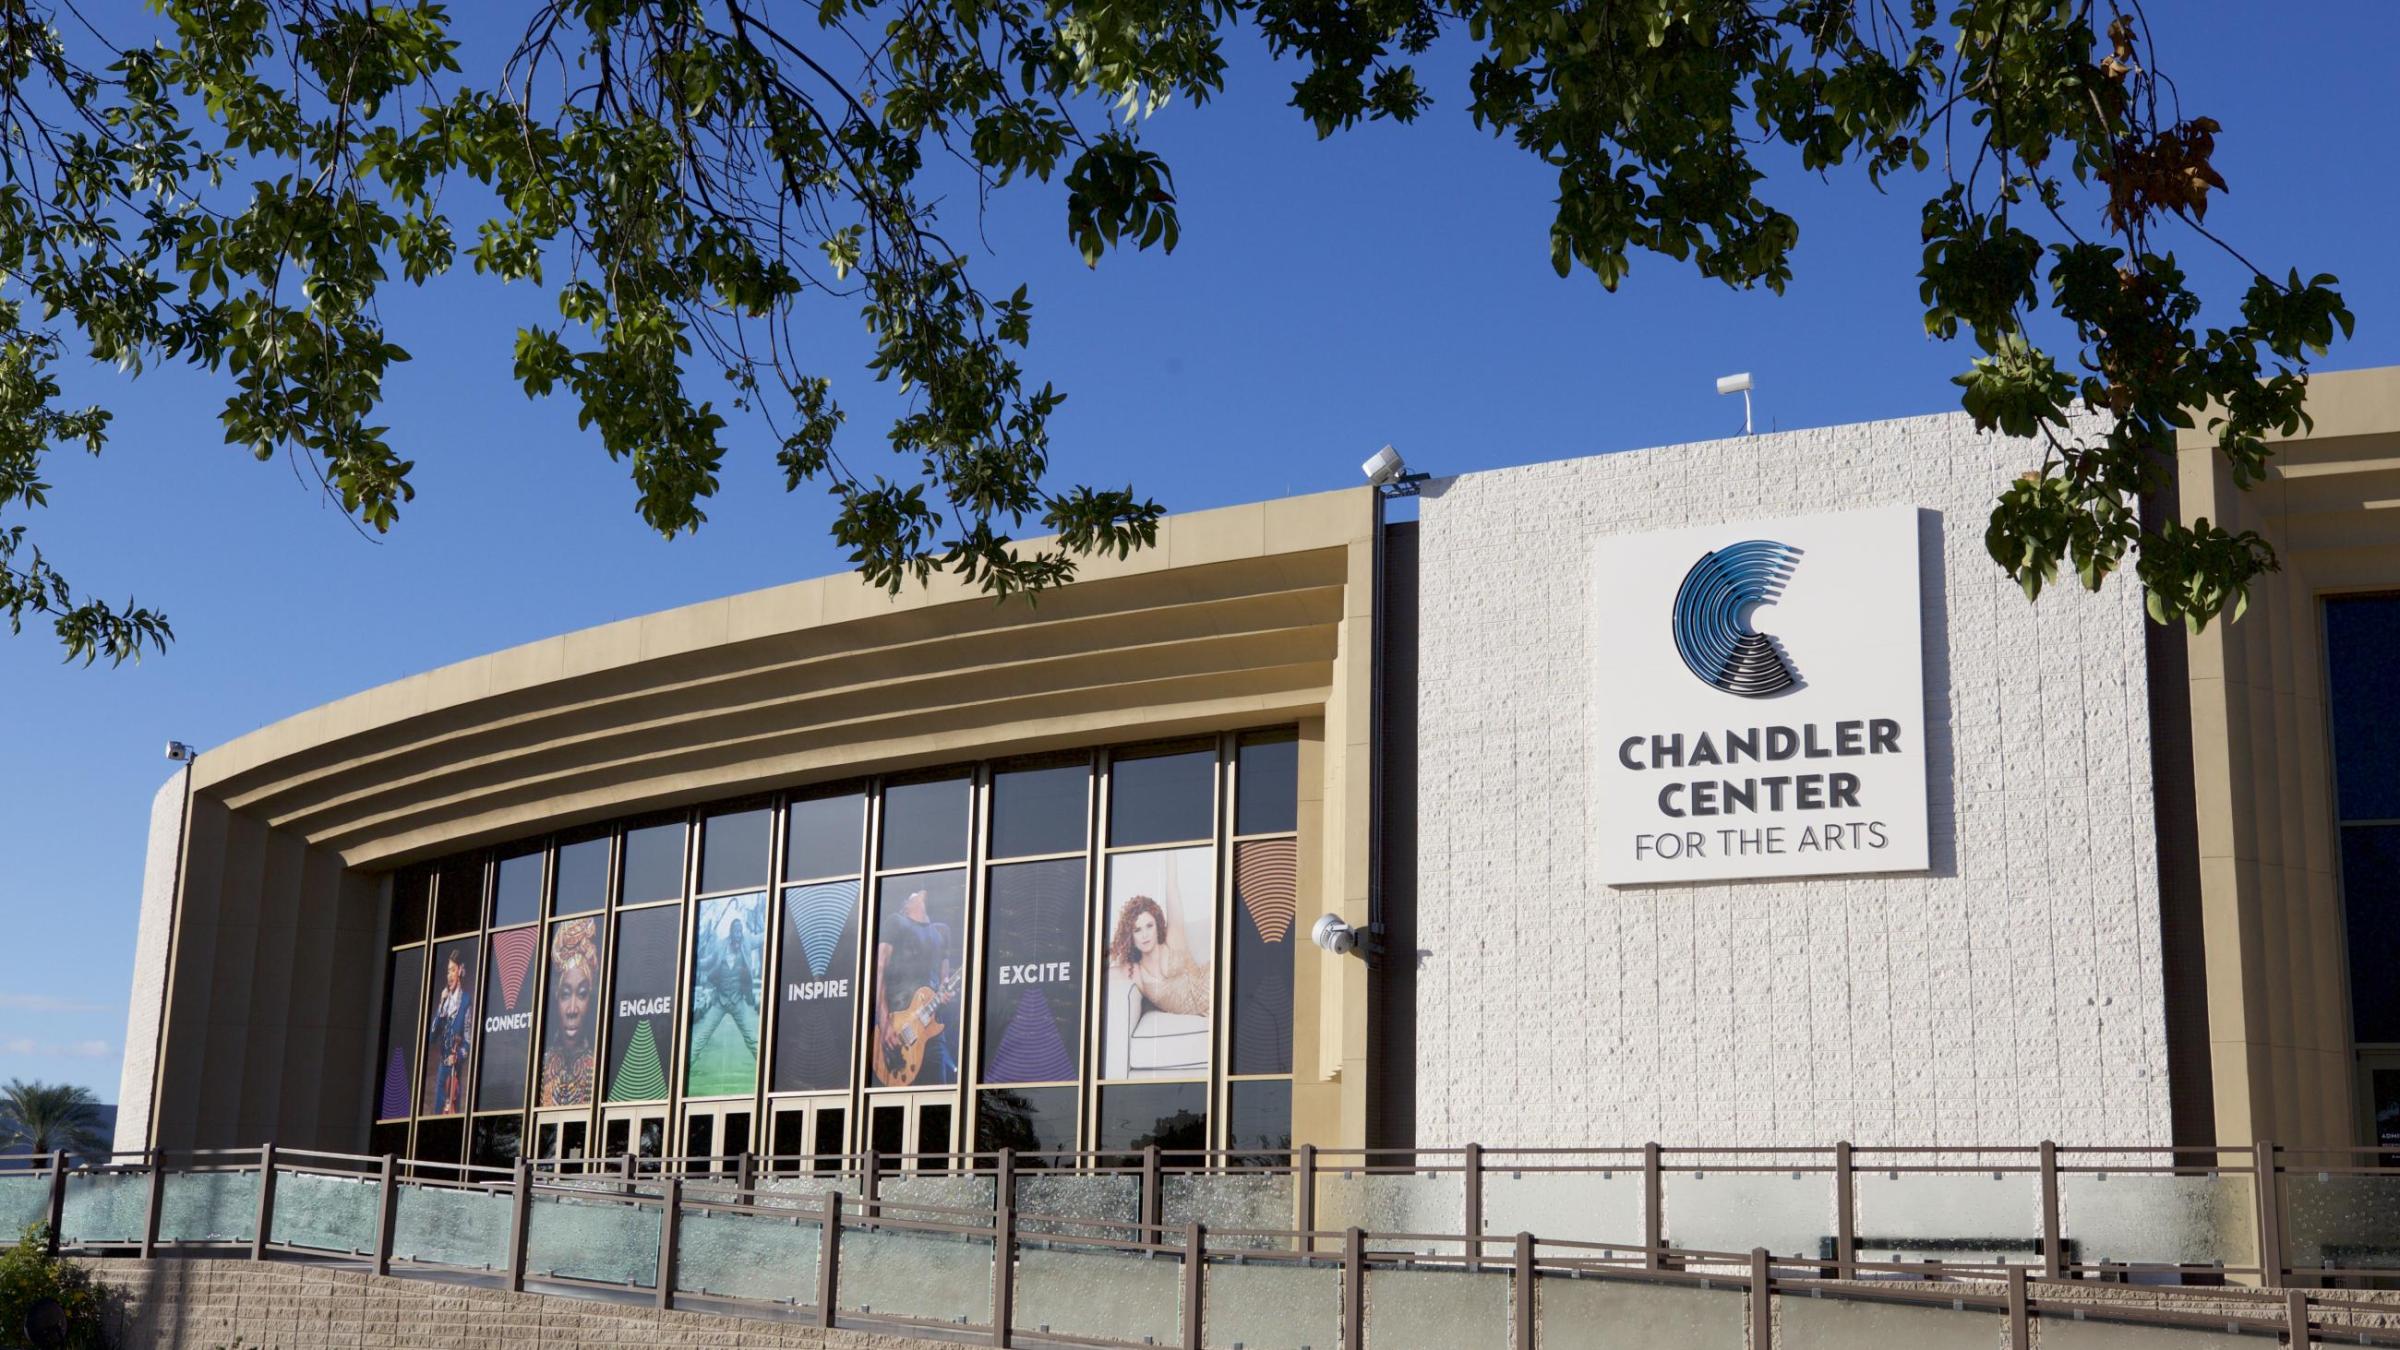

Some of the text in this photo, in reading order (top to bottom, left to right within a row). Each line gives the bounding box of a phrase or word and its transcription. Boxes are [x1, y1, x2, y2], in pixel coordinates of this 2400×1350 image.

[1619, 718, 1902, 770] CHANDLER
[1658, 772, 1861, 818] CENTER
[1636, 820, 1889, 861] FOR THE ARTS
[999, 961, 1071, 985] EXCITE
[788, 979, 849, 1001] INSPIRE
[619, 996, 672, 1017] ENGAGE
[485, 1012, 533, 1033] CONNECT
